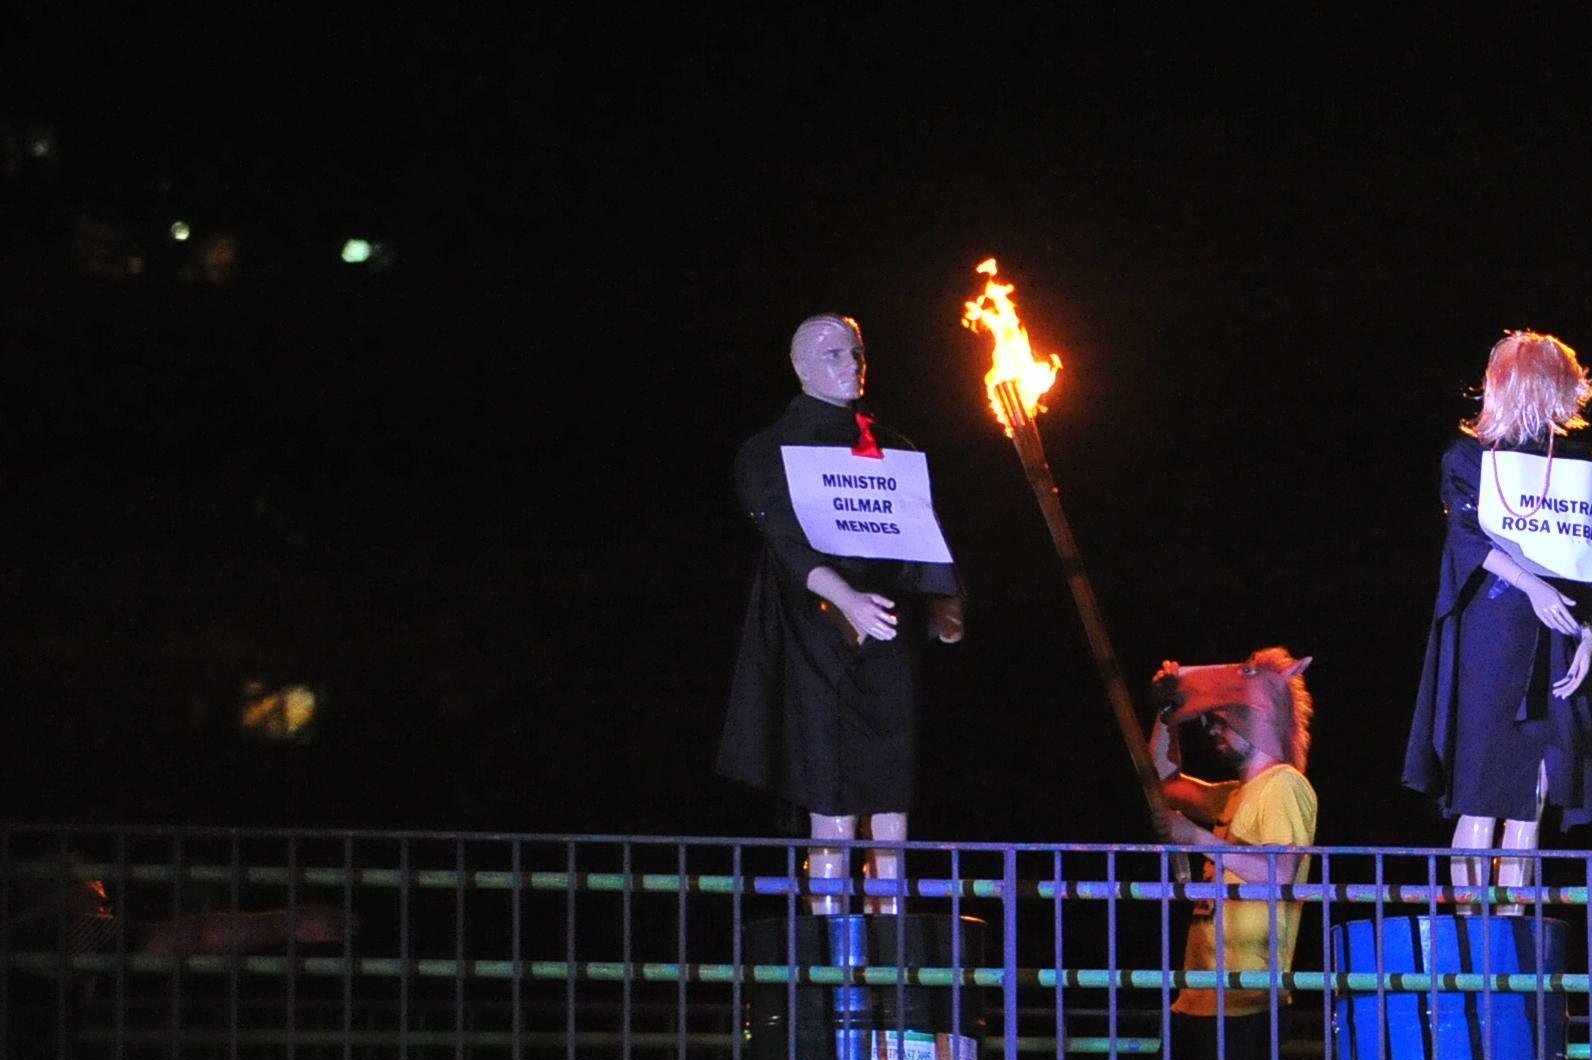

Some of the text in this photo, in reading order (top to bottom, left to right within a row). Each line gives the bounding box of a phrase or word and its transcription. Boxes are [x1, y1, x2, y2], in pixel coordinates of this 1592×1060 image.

[822, 473, 897, 492] MINISTRO
[832, 497, 893, 514] GILMAR
[835, 518, 901, 535] MENDES
[1502, 516, 1551, 533] ROSA
